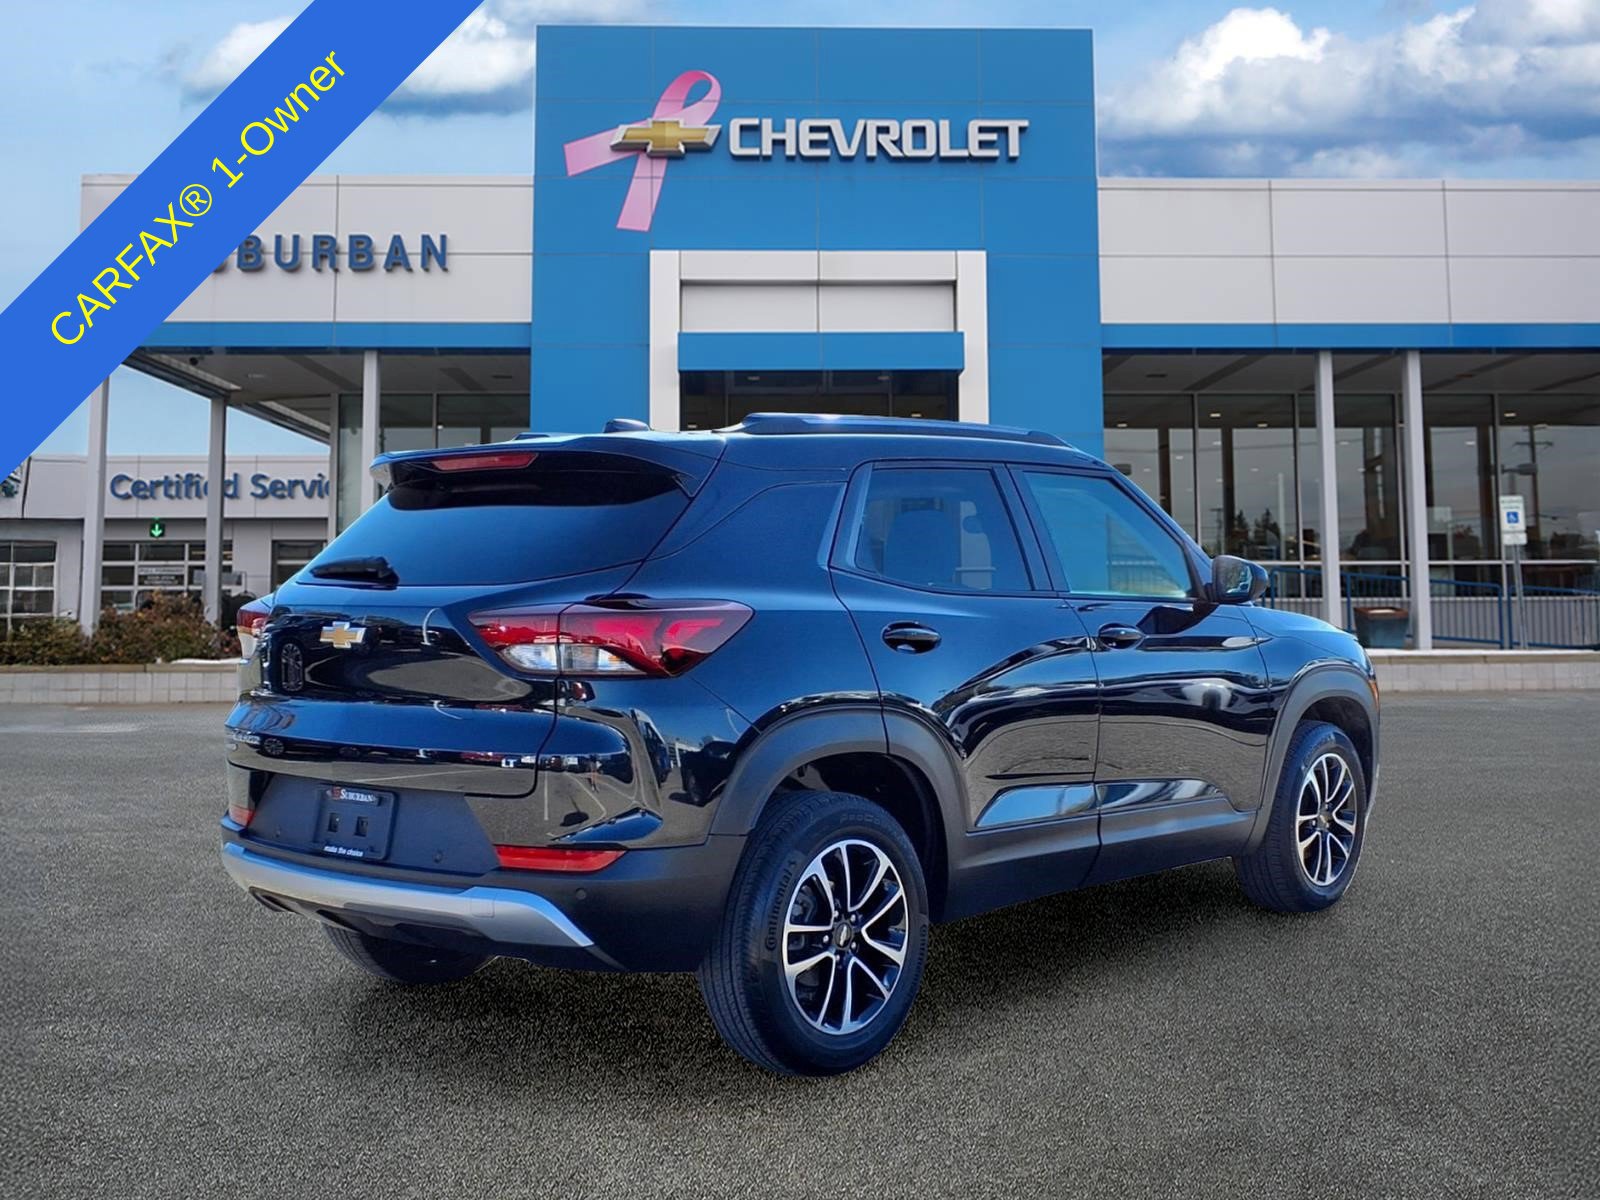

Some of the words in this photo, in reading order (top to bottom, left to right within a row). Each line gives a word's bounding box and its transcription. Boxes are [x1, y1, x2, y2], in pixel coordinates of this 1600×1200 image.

[729, 118, 1029, 160] CHEVROLET
[110, 473, 240, 501] Certifid
[250, 473, 329, 501] Servi
[501, 758, 517, 768] LT
